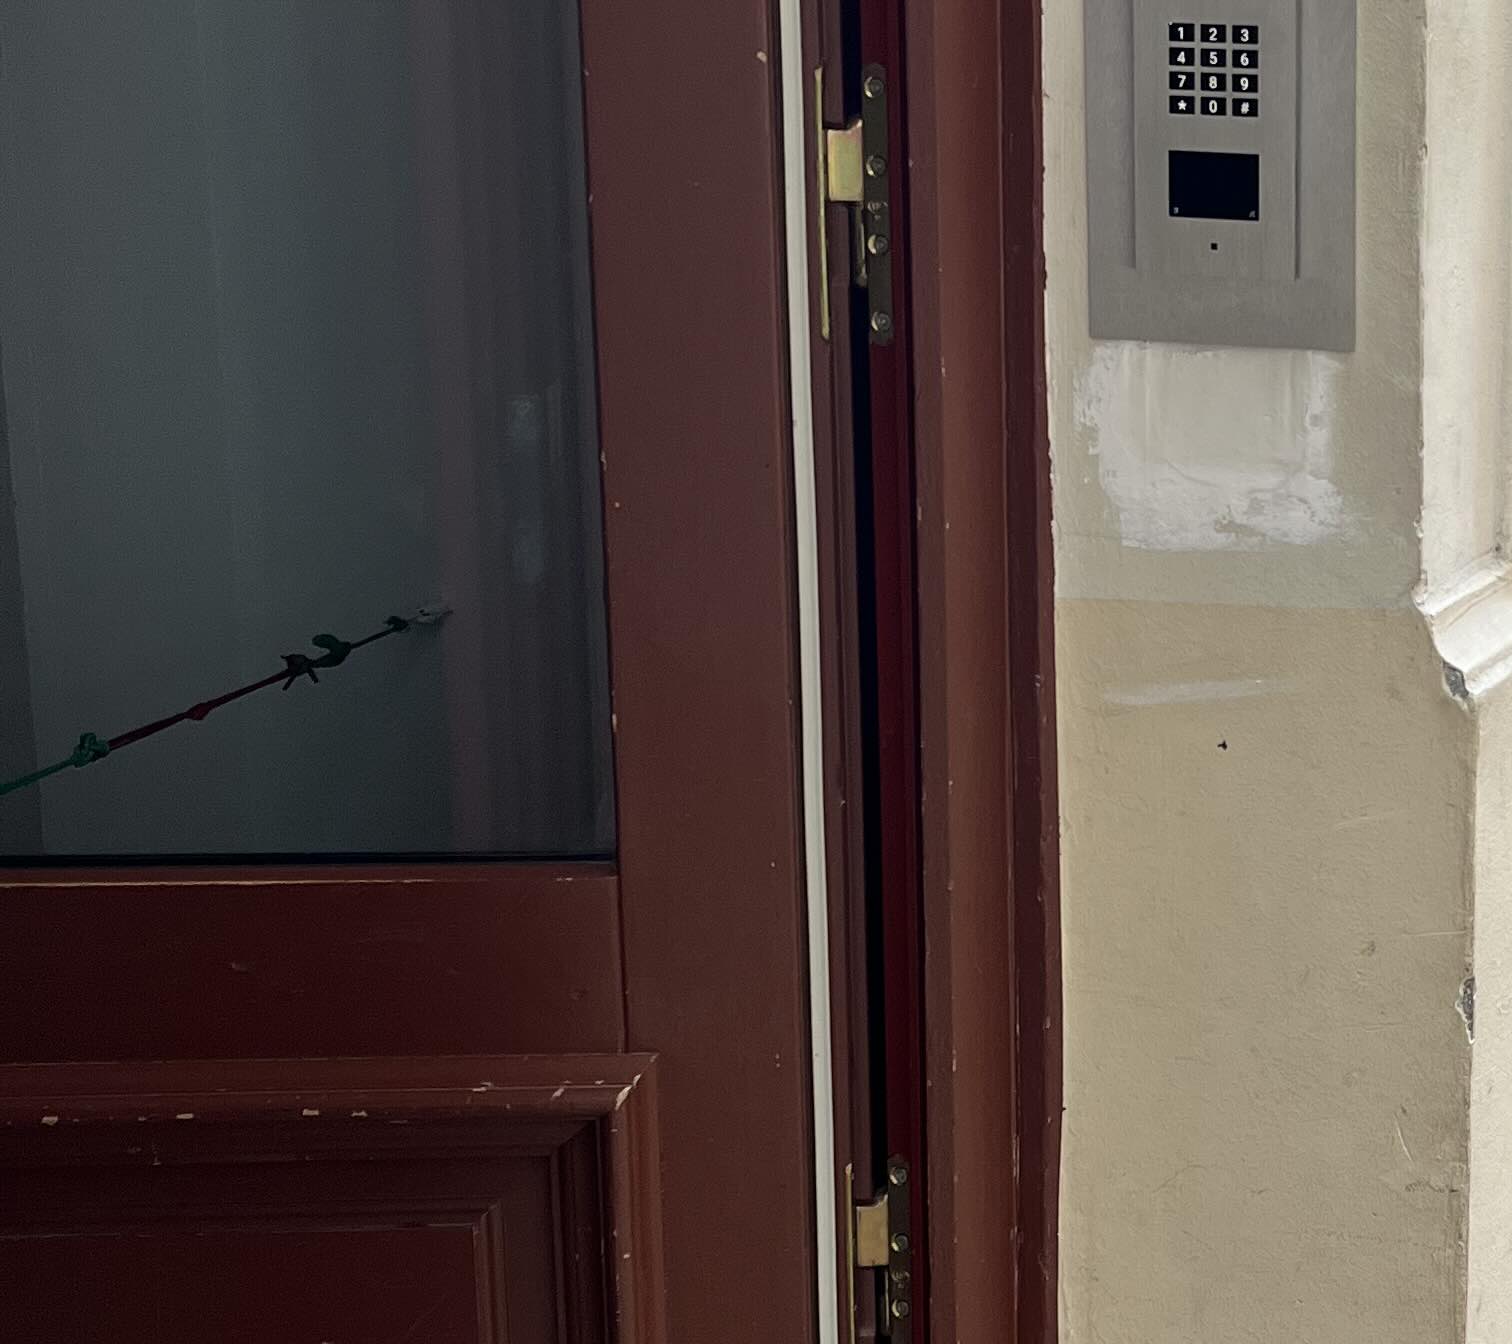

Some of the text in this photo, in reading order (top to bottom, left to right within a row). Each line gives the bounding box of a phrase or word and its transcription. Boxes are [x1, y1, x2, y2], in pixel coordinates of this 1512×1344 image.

[1177, 26, 1249, 42] 1 2 3
[1176, 51, 1249, 66] 4 5 6
[1177, 74, 1249, 91] 7 8 9
[1208, 99, 1218, 114] 0
